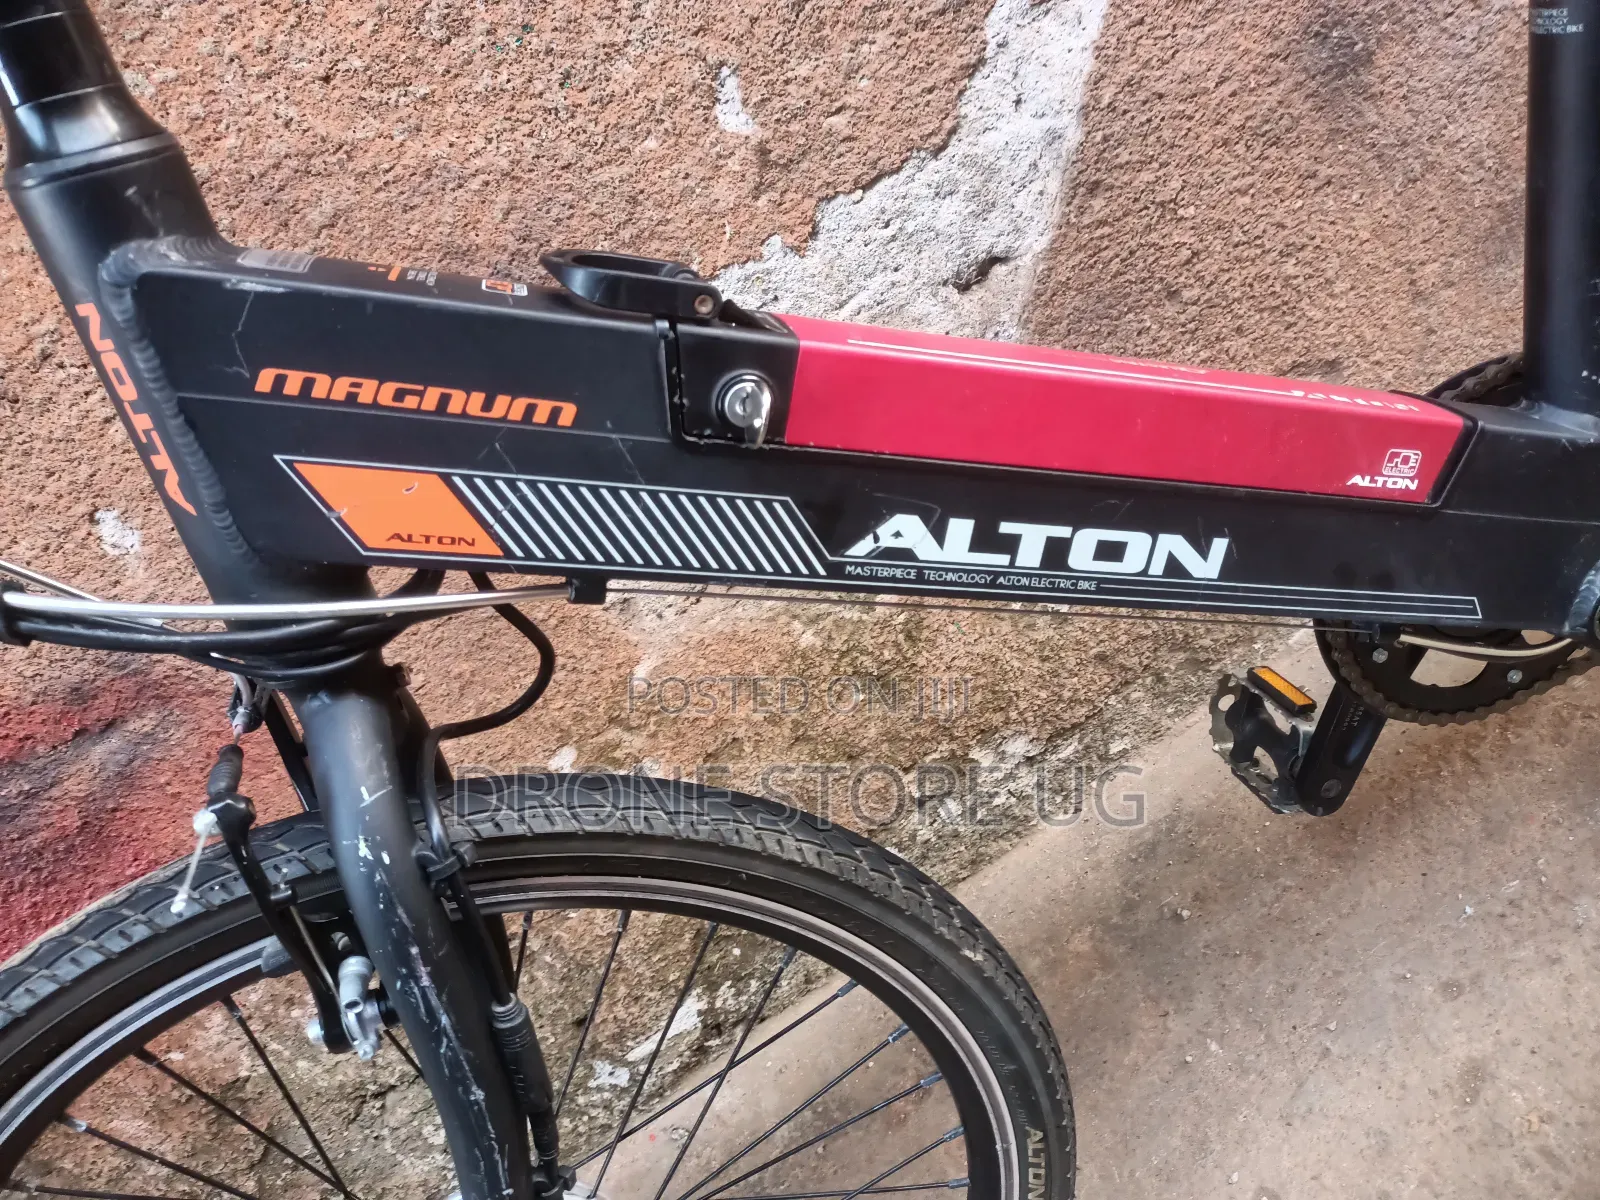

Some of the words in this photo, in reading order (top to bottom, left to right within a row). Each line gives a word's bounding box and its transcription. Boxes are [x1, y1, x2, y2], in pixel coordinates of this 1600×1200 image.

[1566, 23, 1584, 33] BIKE
[75, 303, 197, 517] ALTON
[254, 366, 578, 428] MAGNUM
[1345, 474, 1419, 490] ALTON
[1385, 466, 1415, 475] ELECTRIC
[386, 532, 476, 548] ALTON
[844, 512, 1231, 580] ALTON
[844, 564, 917, 580] MASTERPIECE
[922, 570, 993, 585] TECHNOLOGY
[996, 575, 1030, 587] ALTON
[1030, 577, 1077, 590] ELECTRIC
[1077, 580, 1098, 591] BIKE
[1025, 1126, 1046, 1200] ALTON
